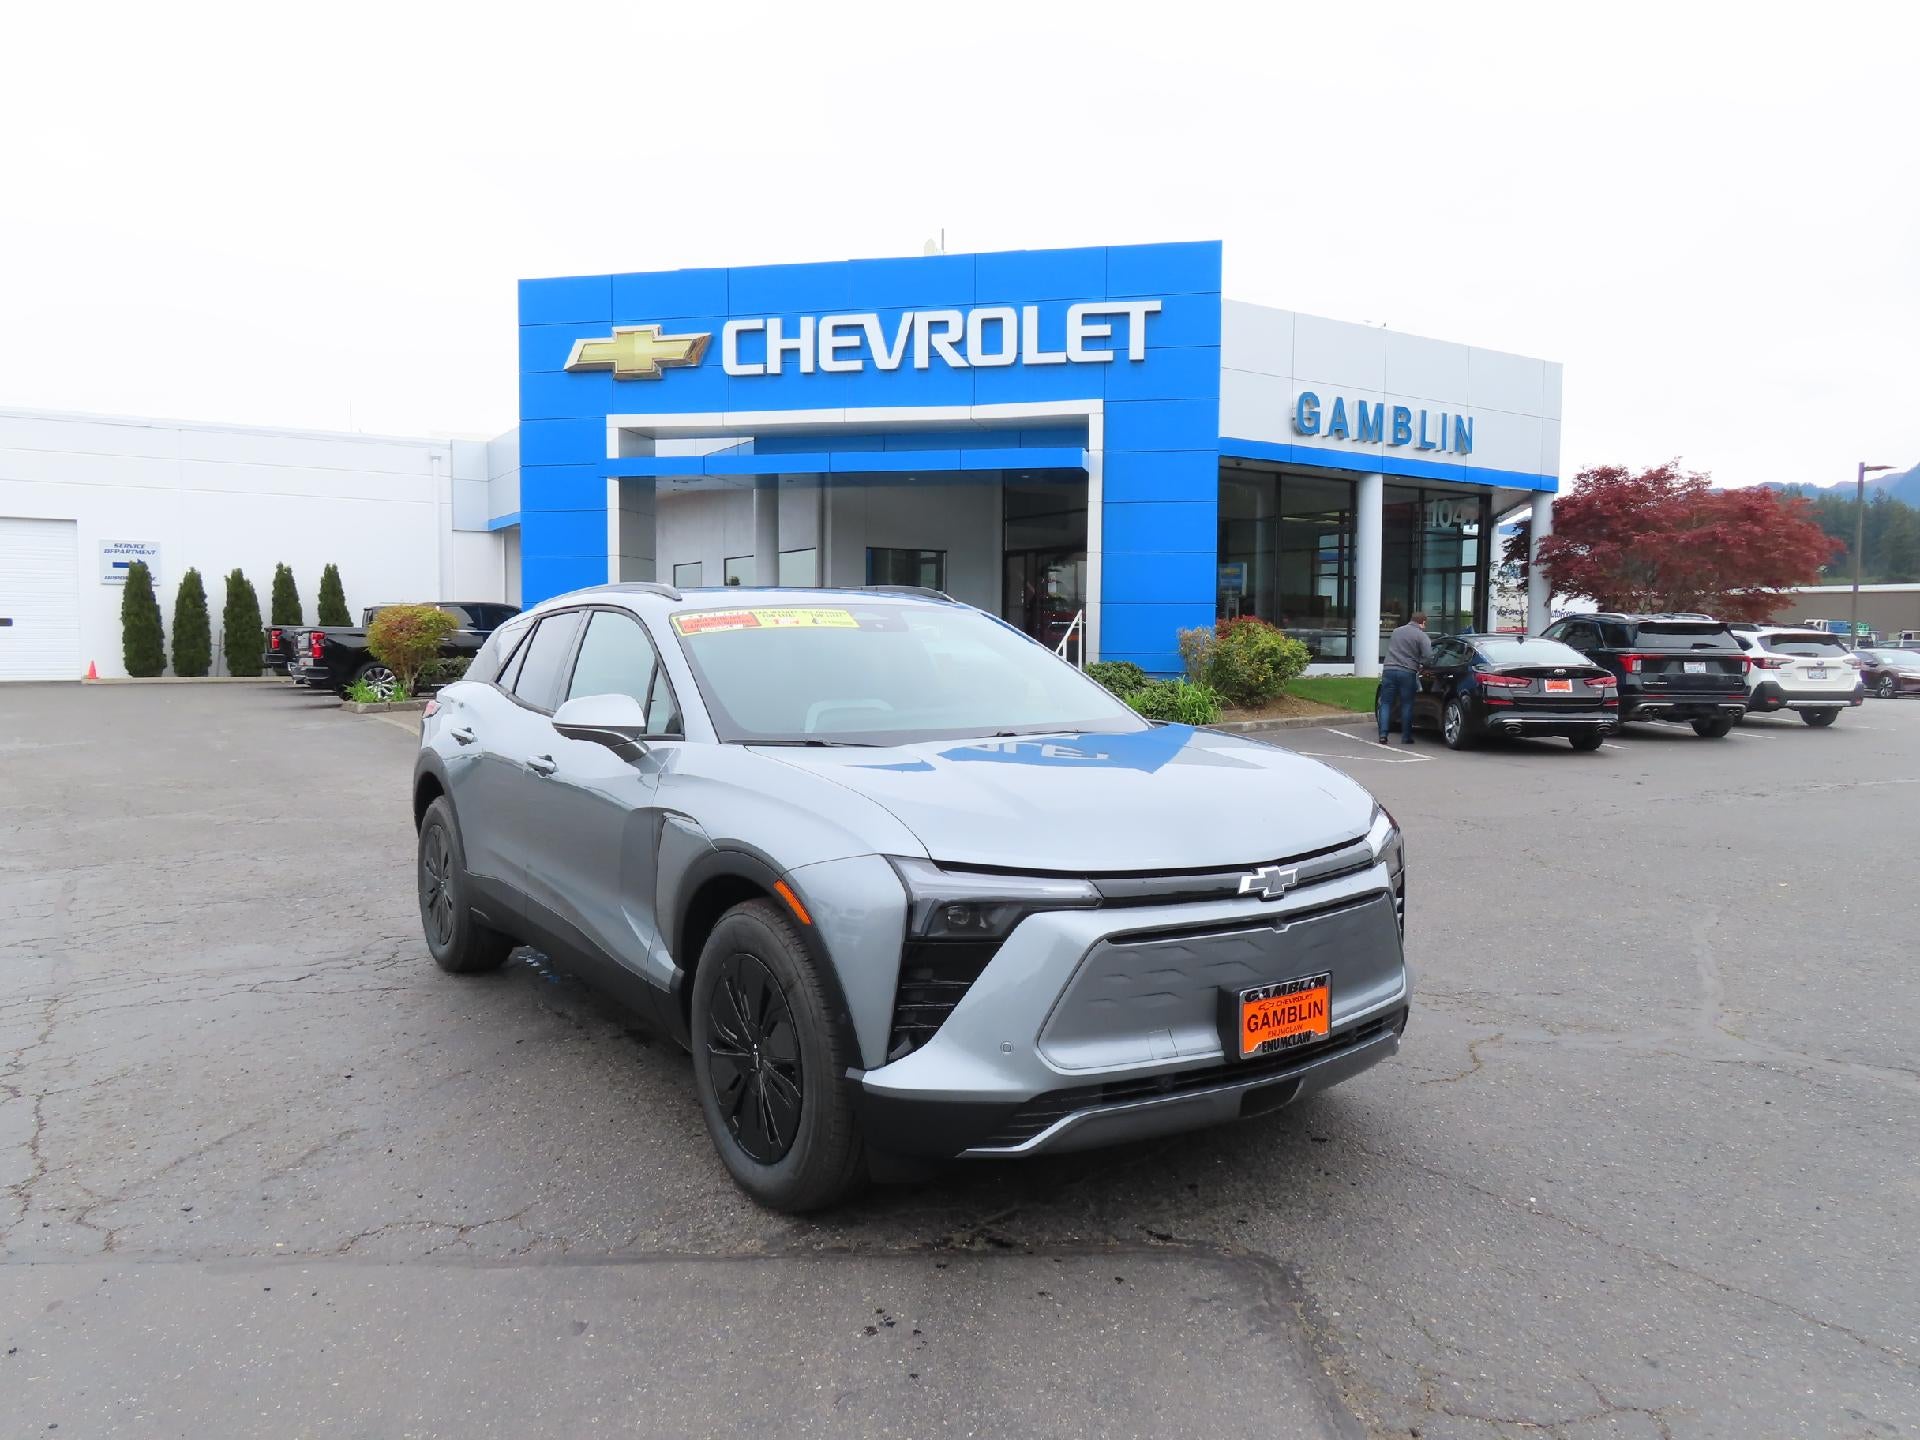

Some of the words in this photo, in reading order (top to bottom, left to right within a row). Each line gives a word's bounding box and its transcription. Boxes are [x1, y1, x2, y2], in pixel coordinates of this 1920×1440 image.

[722, 300, 1162, 376] CHEVROLET
[1294, 391, 1474, 455] GAMBLIN
[1245, 976, 1327, 1003] GAMBLIN
[1276, 994, 1313, 1007] CHEVROLET
[1247, 1000, 1323, 1033] GAMBLIN
[1261, 1030, 1312, 1053] ENUMCLAW
[1267, 1024, 1304, 1038] ENUMCLAW
